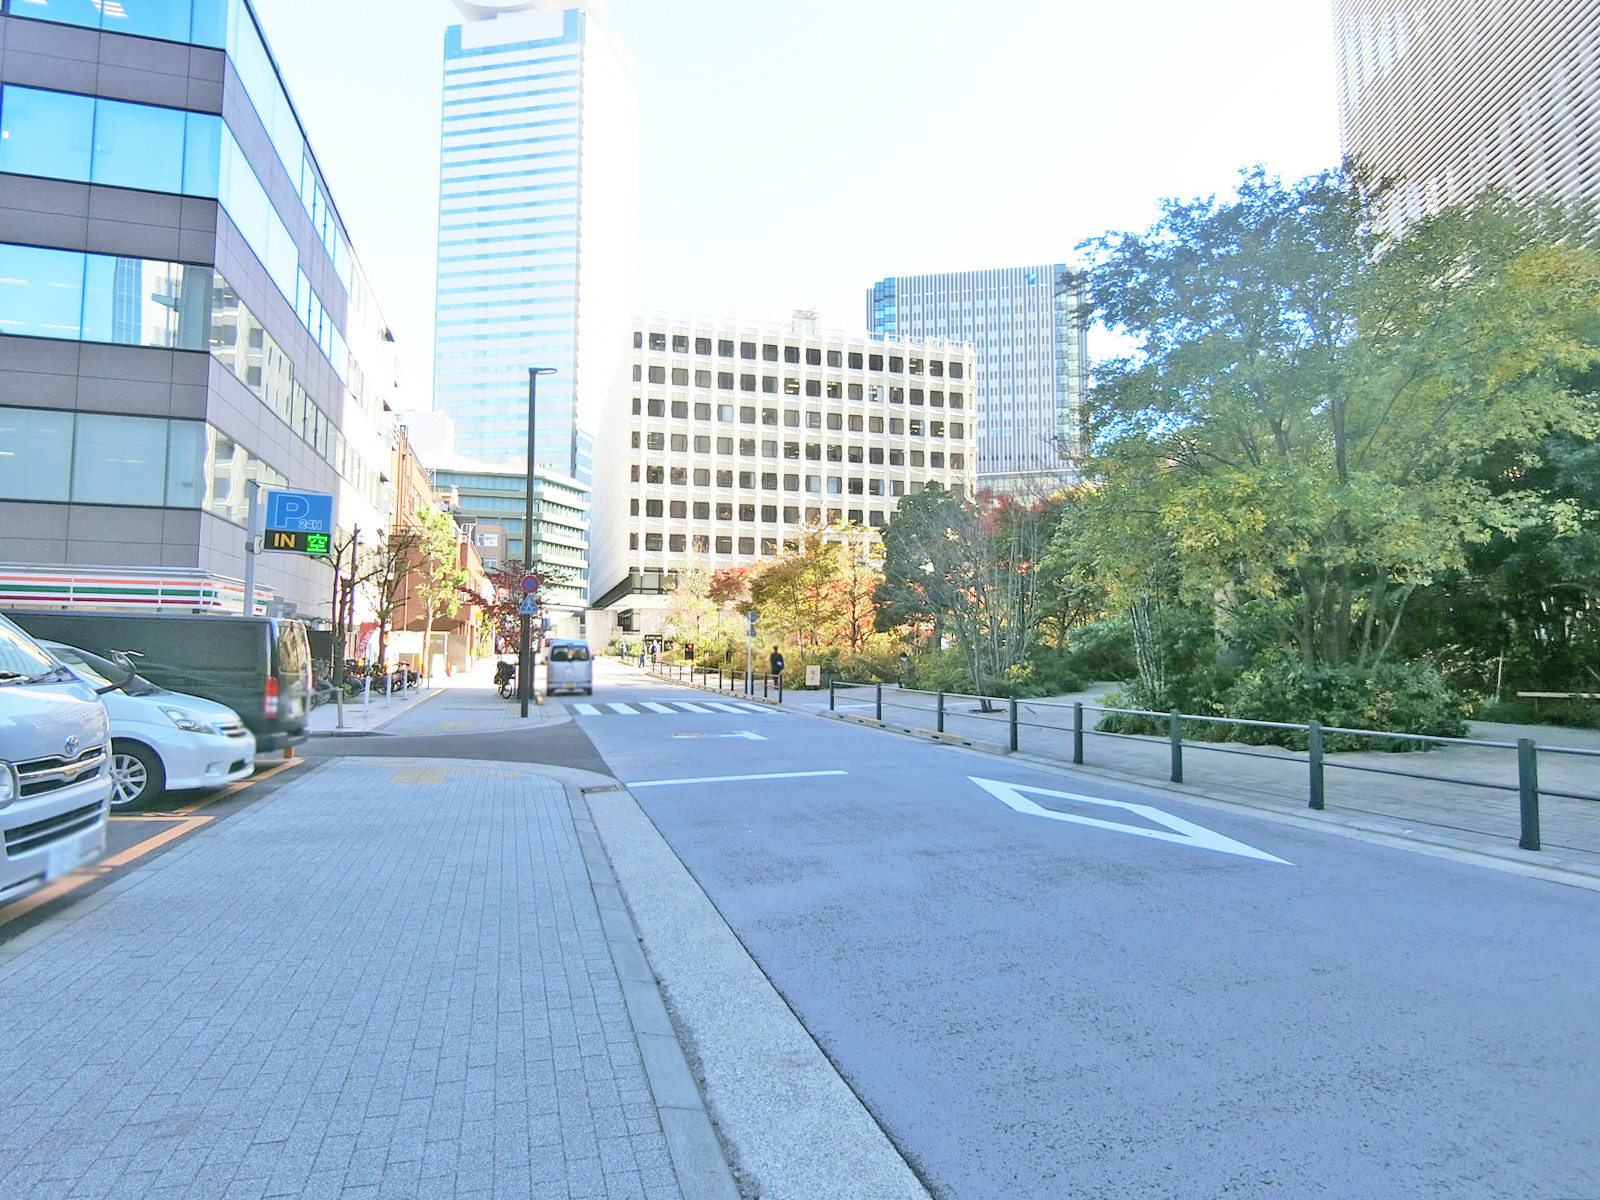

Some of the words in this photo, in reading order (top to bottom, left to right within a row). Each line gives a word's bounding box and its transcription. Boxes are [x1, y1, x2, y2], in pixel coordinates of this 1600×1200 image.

[275, 494, 310, 528] P
[298, 518, 323, 530] 24H
[273, 533, 296, 548] IN
[307, 533, 328, 552] 空
